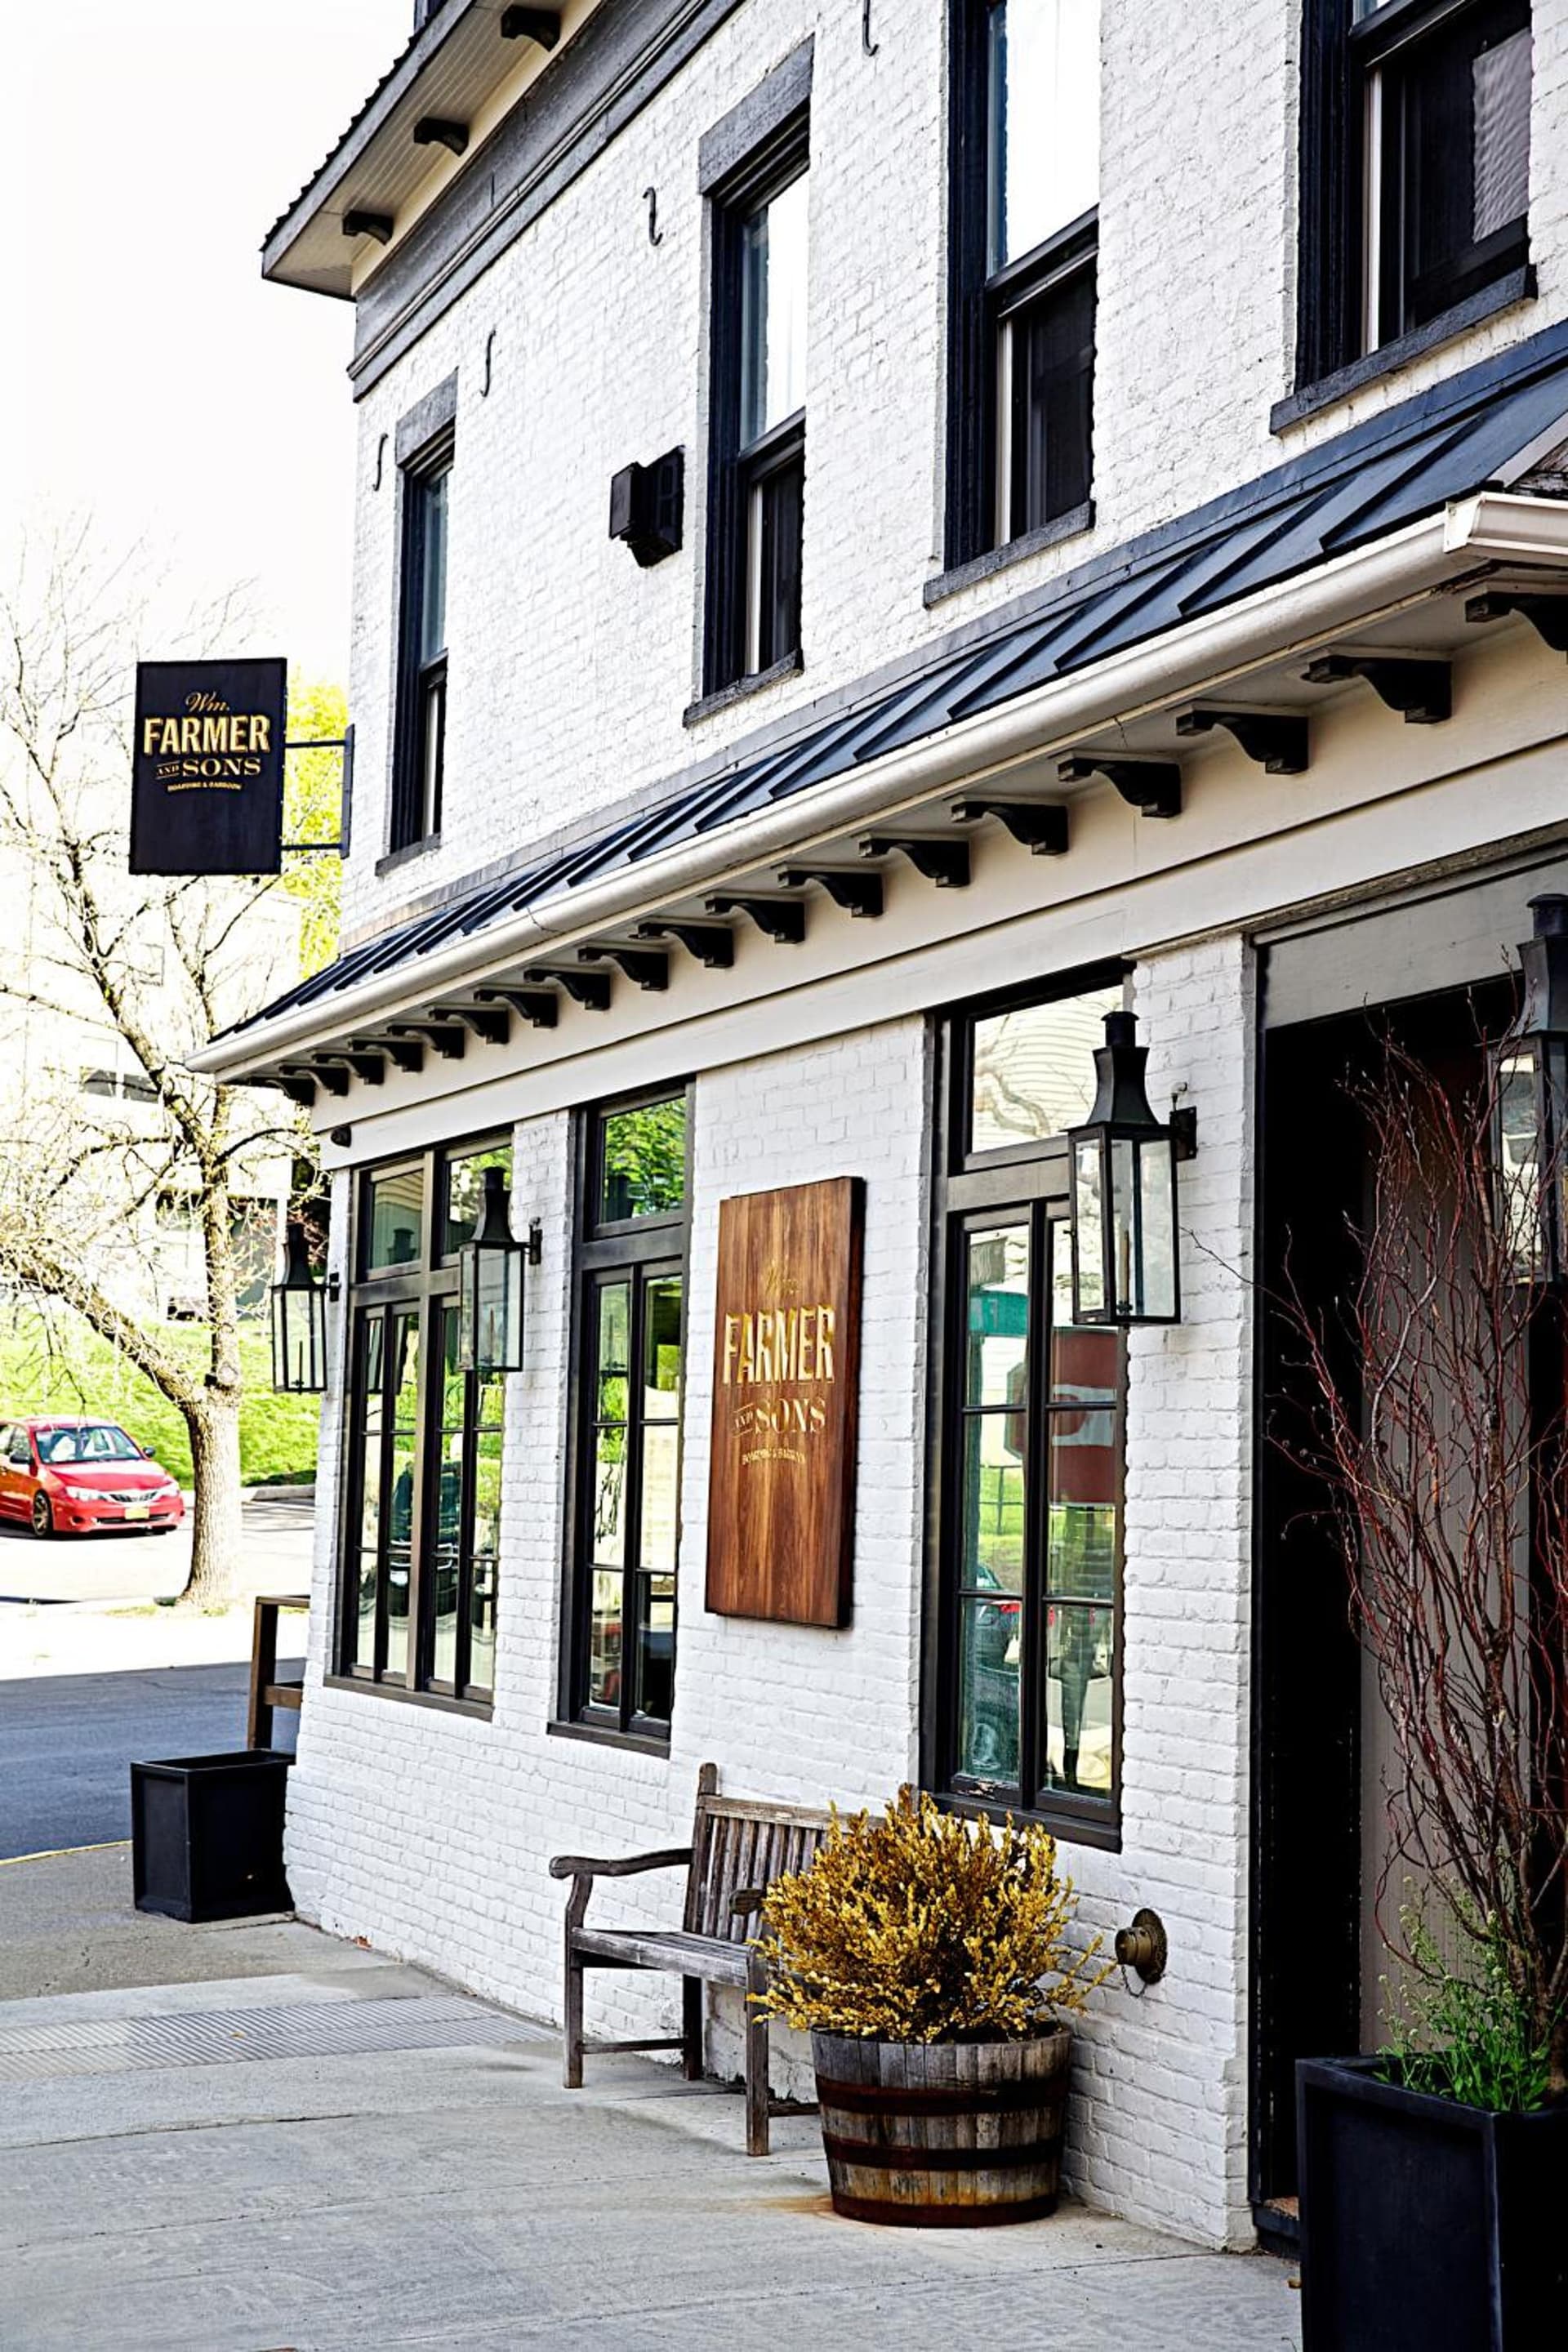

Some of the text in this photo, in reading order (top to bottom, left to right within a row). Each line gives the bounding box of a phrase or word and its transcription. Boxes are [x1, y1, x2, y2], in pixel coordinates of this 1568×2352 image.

[143, 715, 271, 755] FARMER
[182, 758, 261, 777] SONS
[724, 1305, 835, 1384] FARMER
[755, 1397, 826, 1434] SONS
